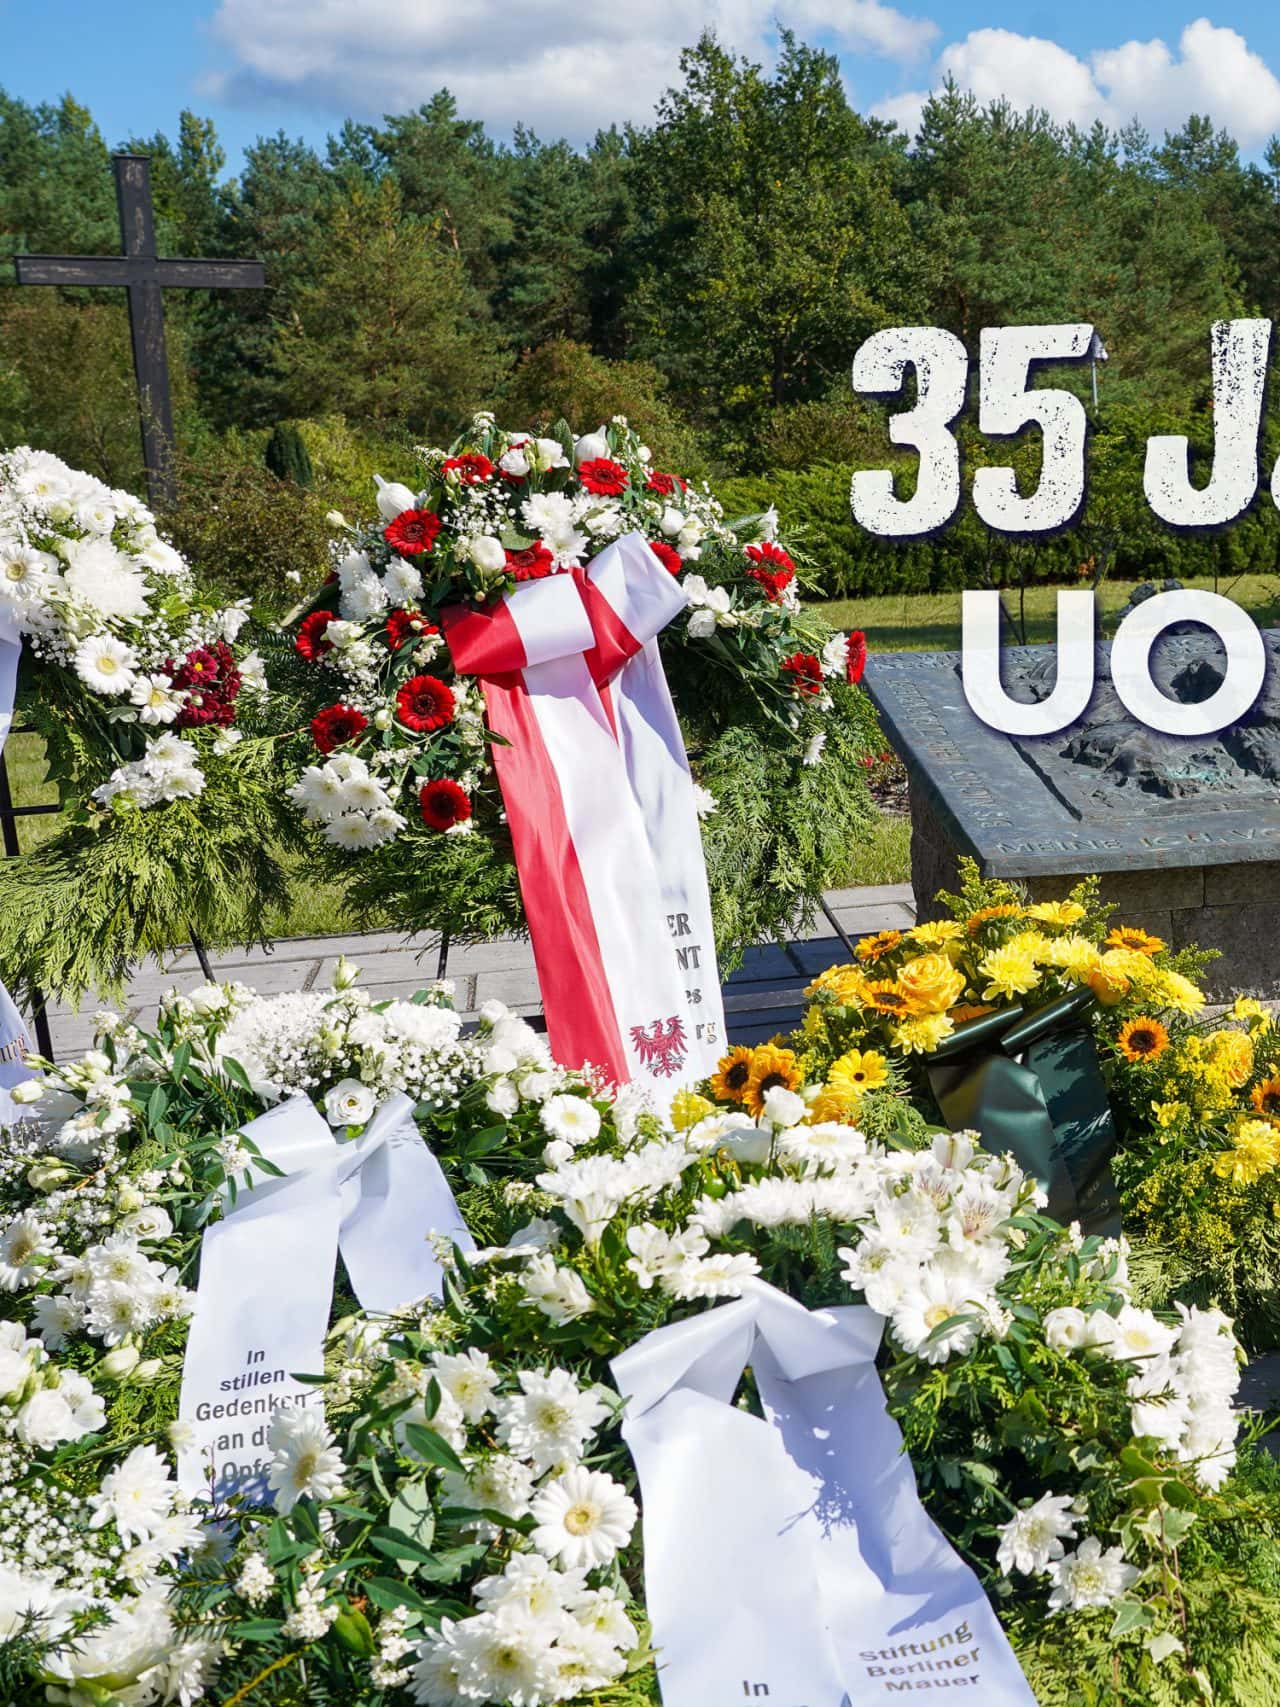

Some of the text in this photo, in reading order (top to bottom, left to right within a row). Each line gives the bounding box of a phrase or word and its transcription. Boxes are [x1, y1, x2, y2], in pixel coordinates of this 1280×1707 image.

[247, 1350, 265, 1365] In
[220, 1369, 285, 1392] stillen
[218, 1425, 272, 1451] an di
[222, 1458, 273, 1484] Opfe
[859, 1620, 974, 1663] Stiftung
[866, 1647, 982, 1678] Berliner
[742, 1680, 769, 1696] In
[884, 1673, 981, 1693] Mauer
